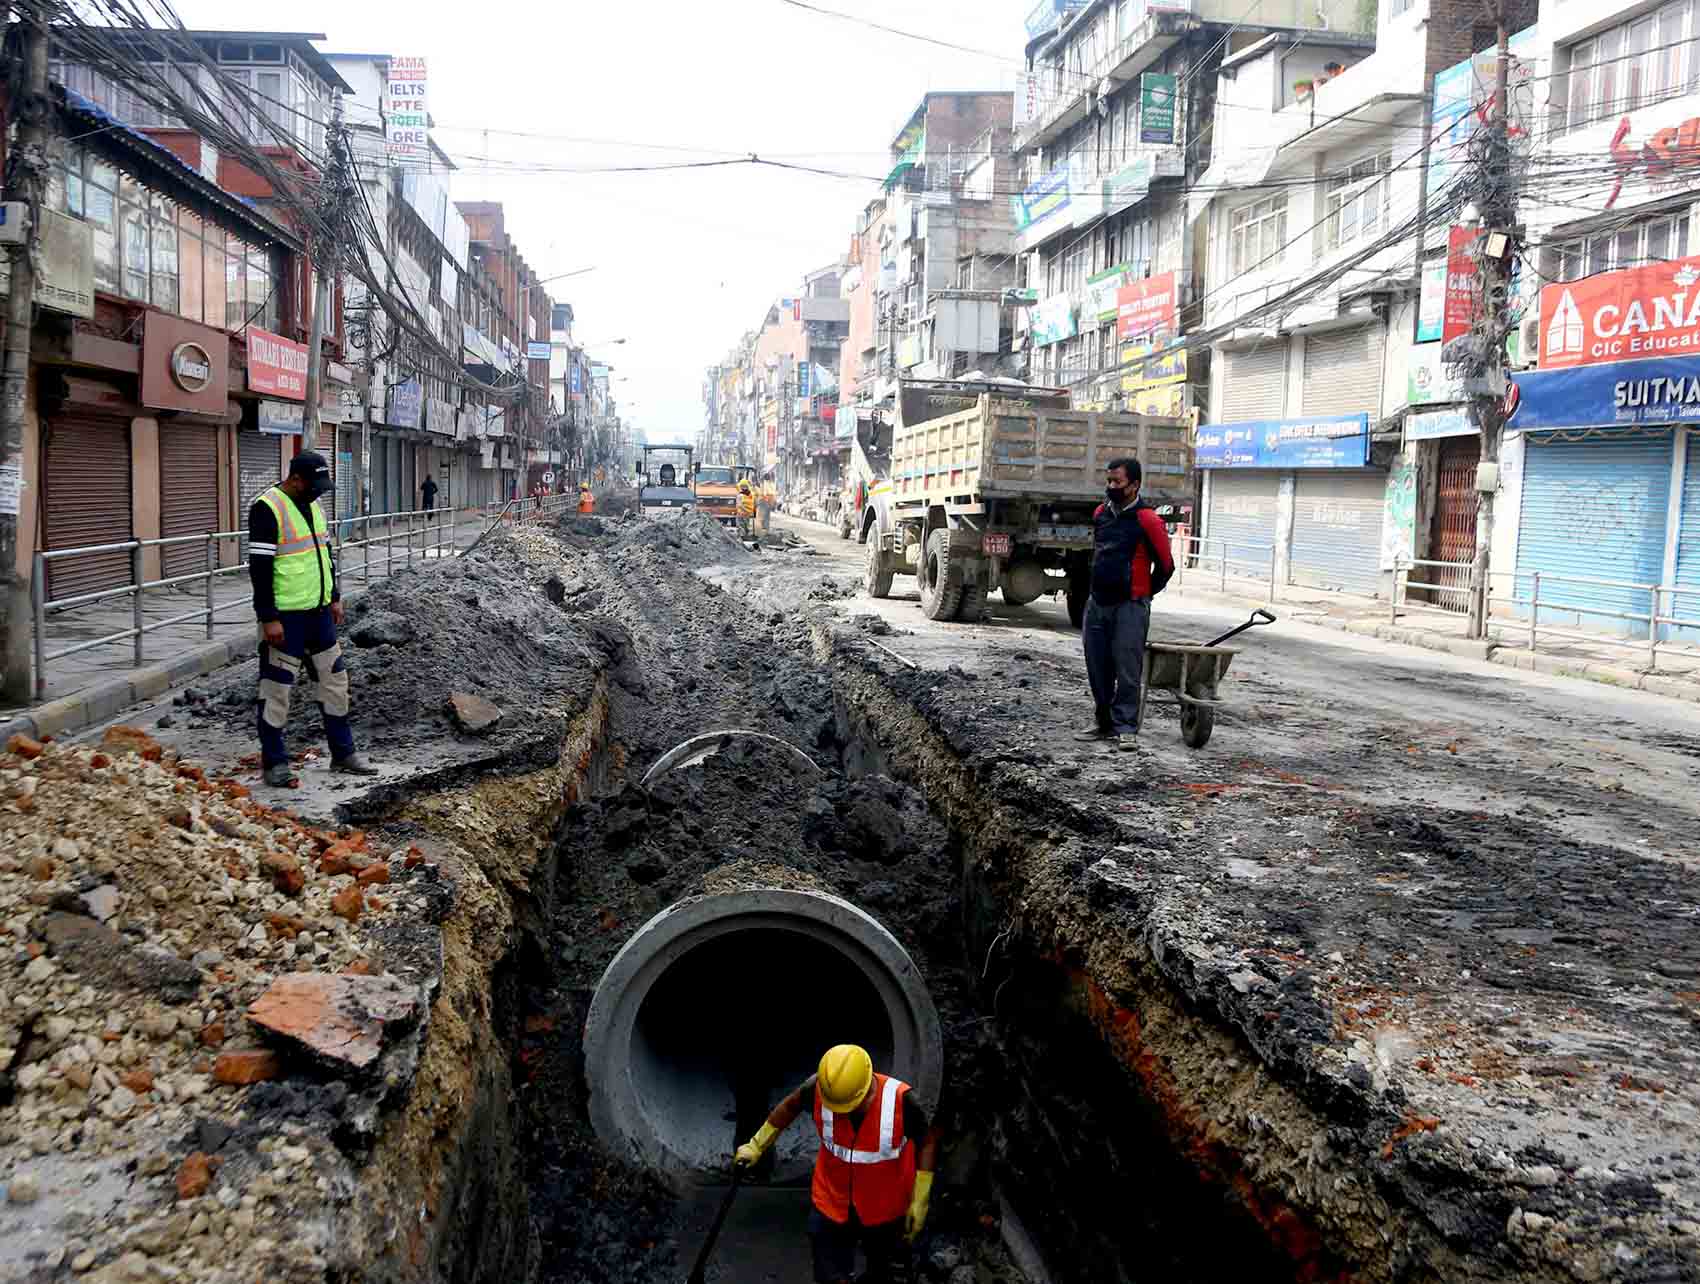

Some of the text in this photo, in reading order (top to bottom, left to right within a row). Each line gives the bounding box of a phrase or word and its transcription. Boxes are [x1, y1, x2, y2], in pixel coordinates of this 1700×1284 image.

[390, 84, 425, 96] IELTS
[392, 100, 423, 111] PTE
[393, 131, 424, 143] GRE
[1592, 341, 1623, 357] CIC
